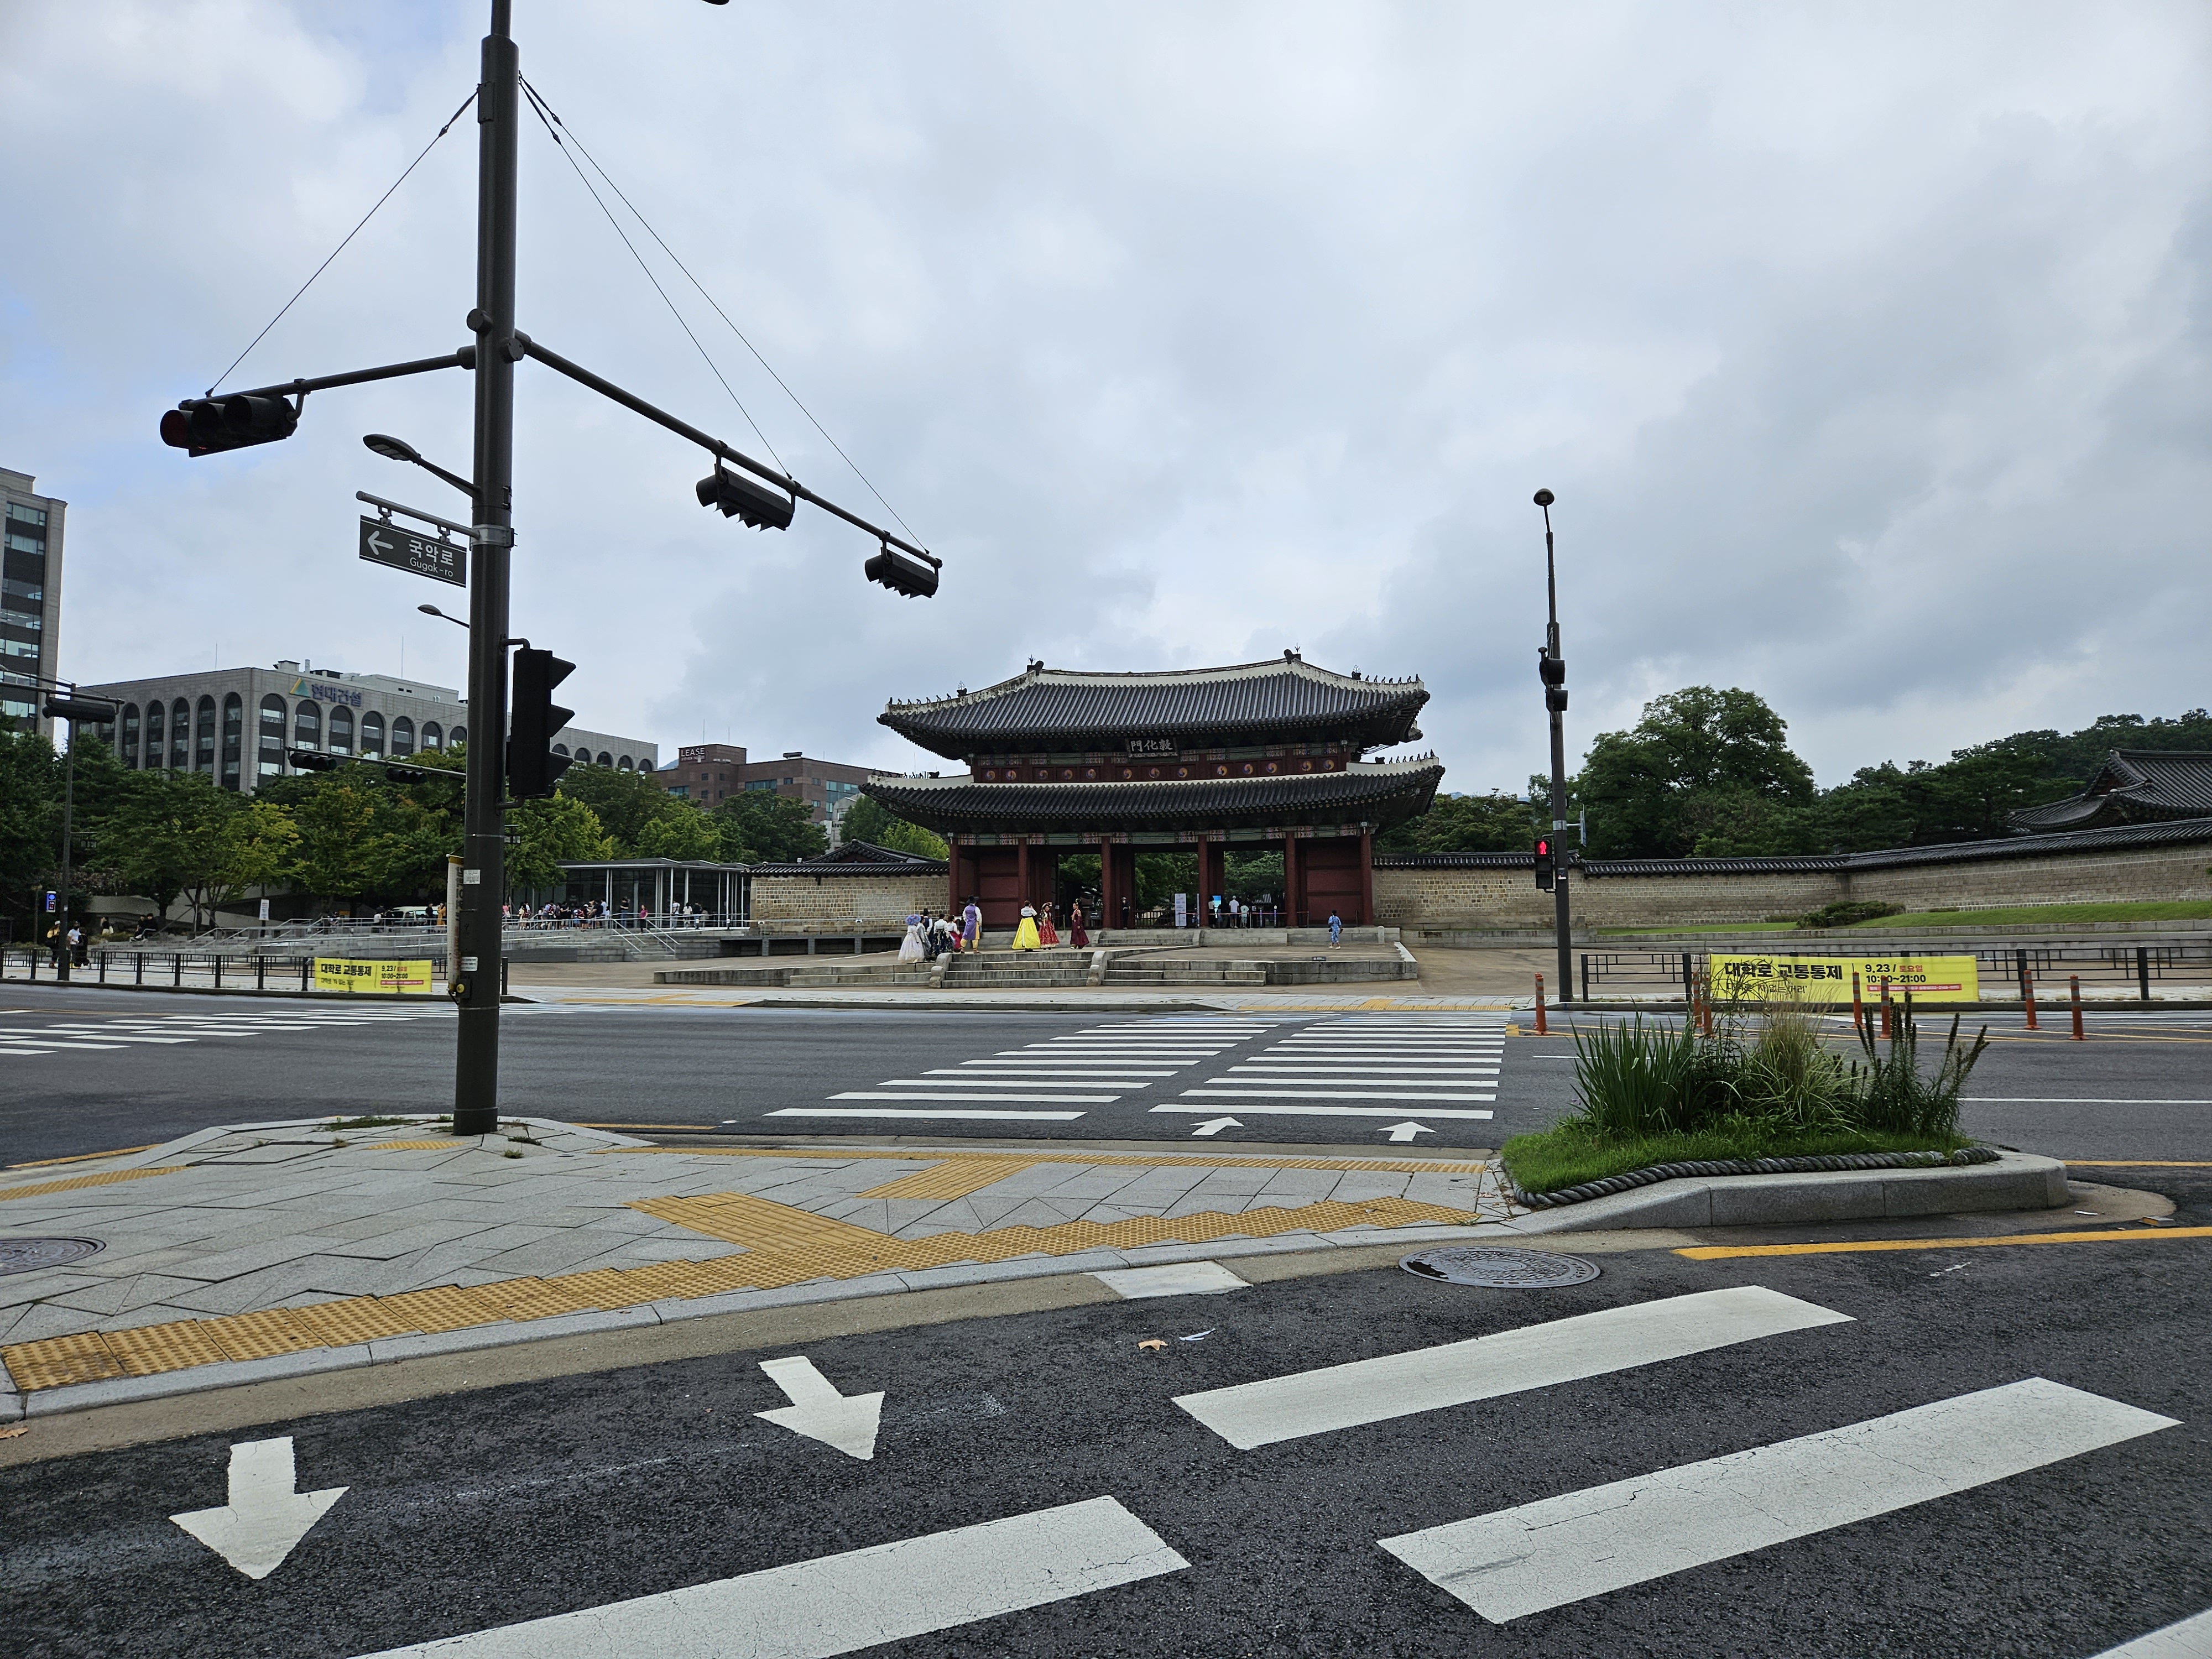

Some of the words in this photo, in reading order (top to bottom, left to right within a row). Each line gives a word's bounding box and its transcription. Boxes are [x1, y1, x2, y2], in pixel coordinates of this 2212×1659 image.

[409, 539, 454, 566] 국악로
[410, 557, 453, 577] Gugak-ro
[311, 684, 362, 707] 현대건설
[681, 748, 705, 757] LEASE
[321, 963, 342, 974] 대학로
[343, 965, 372, 977] 교통통제
[1724, 962, 1773, 978] 대학로
[1778, 964, 1843, 980] 교통통제
[1865, 964, 1890, 973] 9.23
[1866, 974, 1926, 983] 10:0~21:00
